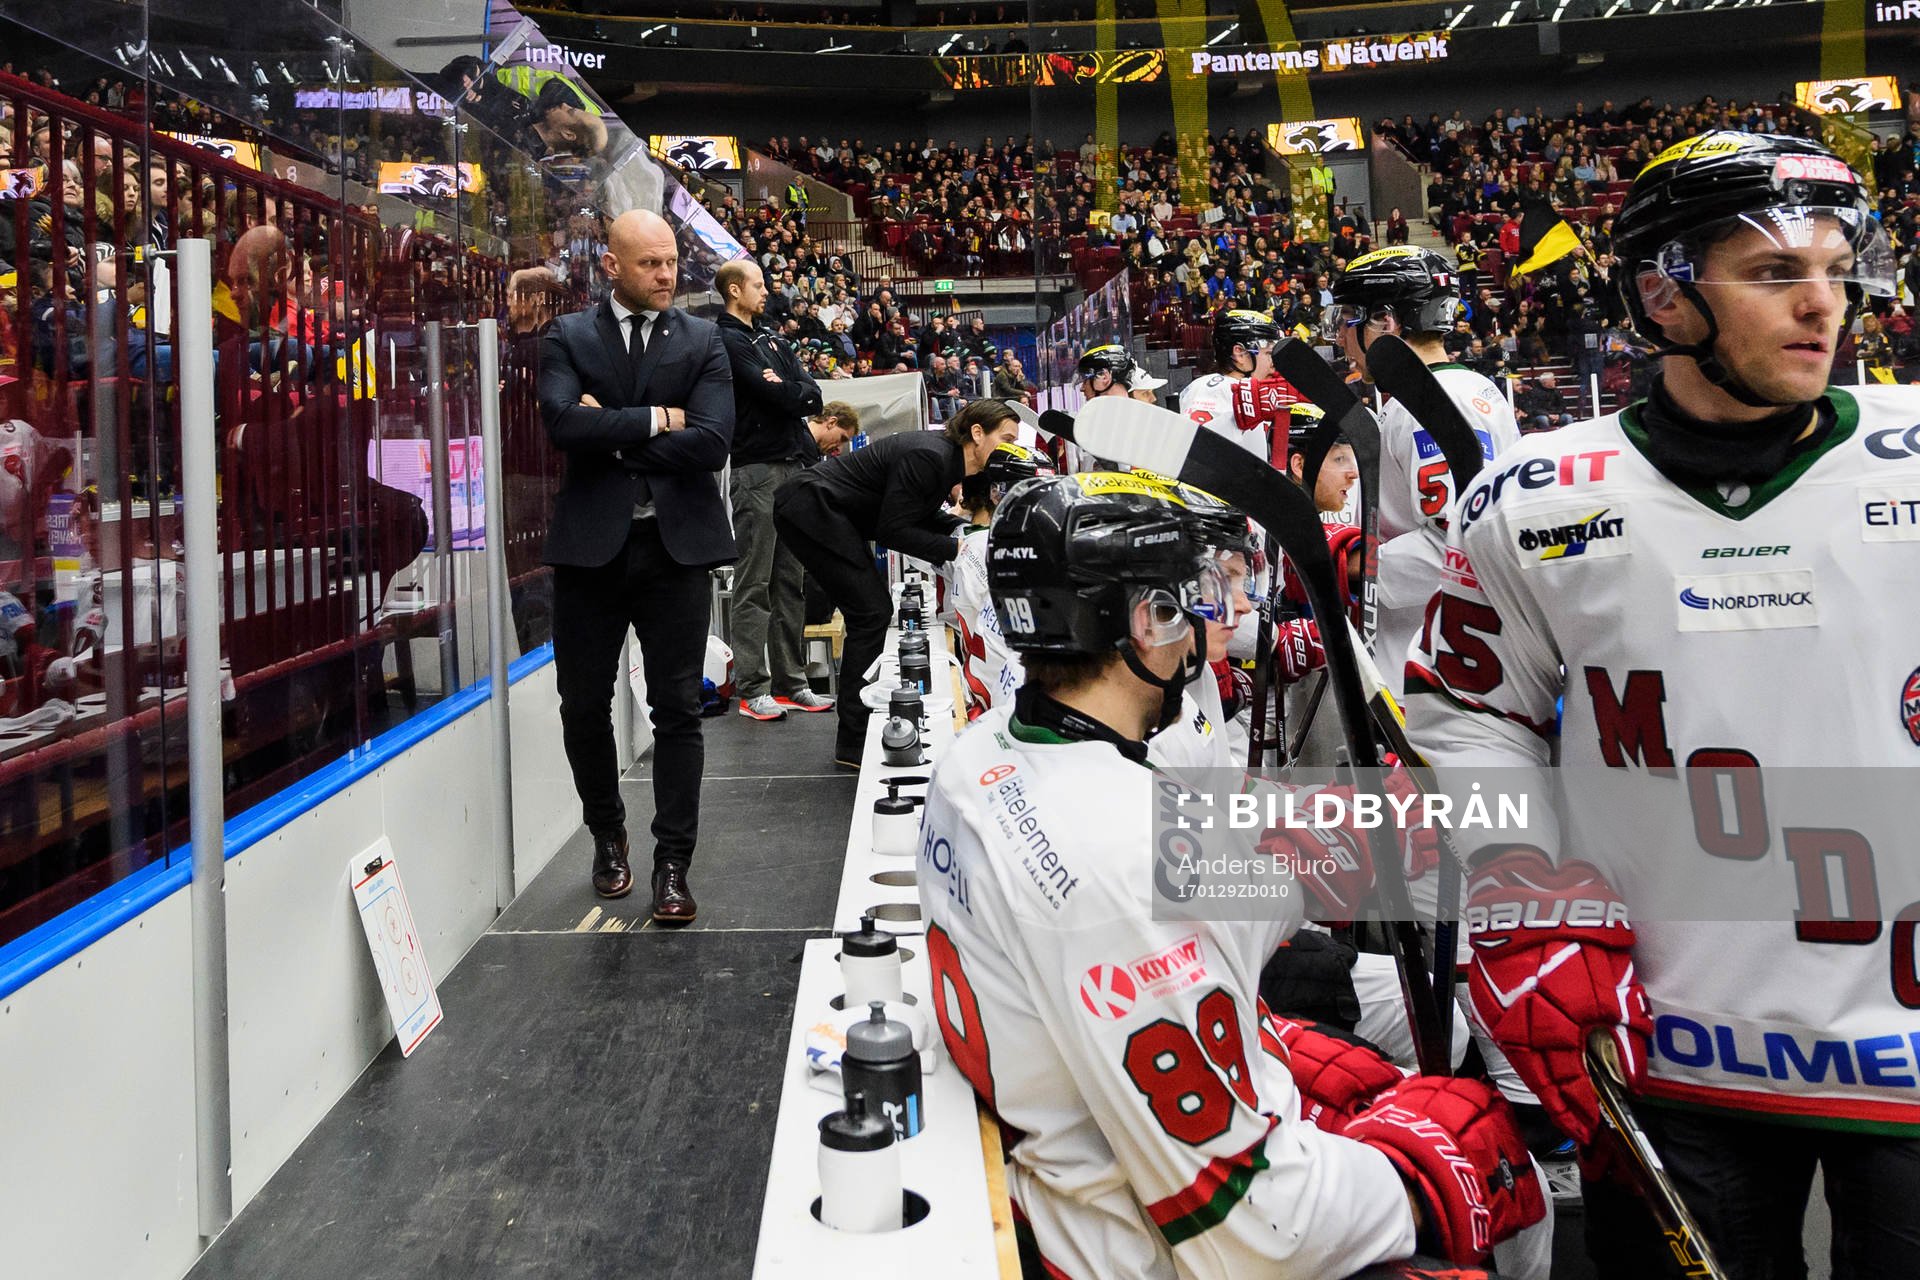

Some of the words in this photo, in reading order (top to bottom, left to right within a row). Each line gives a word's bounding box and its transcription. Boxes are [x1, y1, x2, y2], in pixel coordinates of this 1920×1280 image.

[525, 41, 606, 69] inRiver
[1192, 50, 1319, 74] Panterns
[1328, 37, 1448, 66] Nätverk
[1518, 517, 1624, 551] ÖRNFRAKT
[1701, 545, 1791, 560] BAUER
[1004, 597, 1036, 634] 89
[1712, 591, 1812, 611] NORDTRUCK
[1466, 899, 1631, 934] BAUER
[1122, 986, 1259, 1147] 89
[1645, 1013, 1920, 1089] OLME
